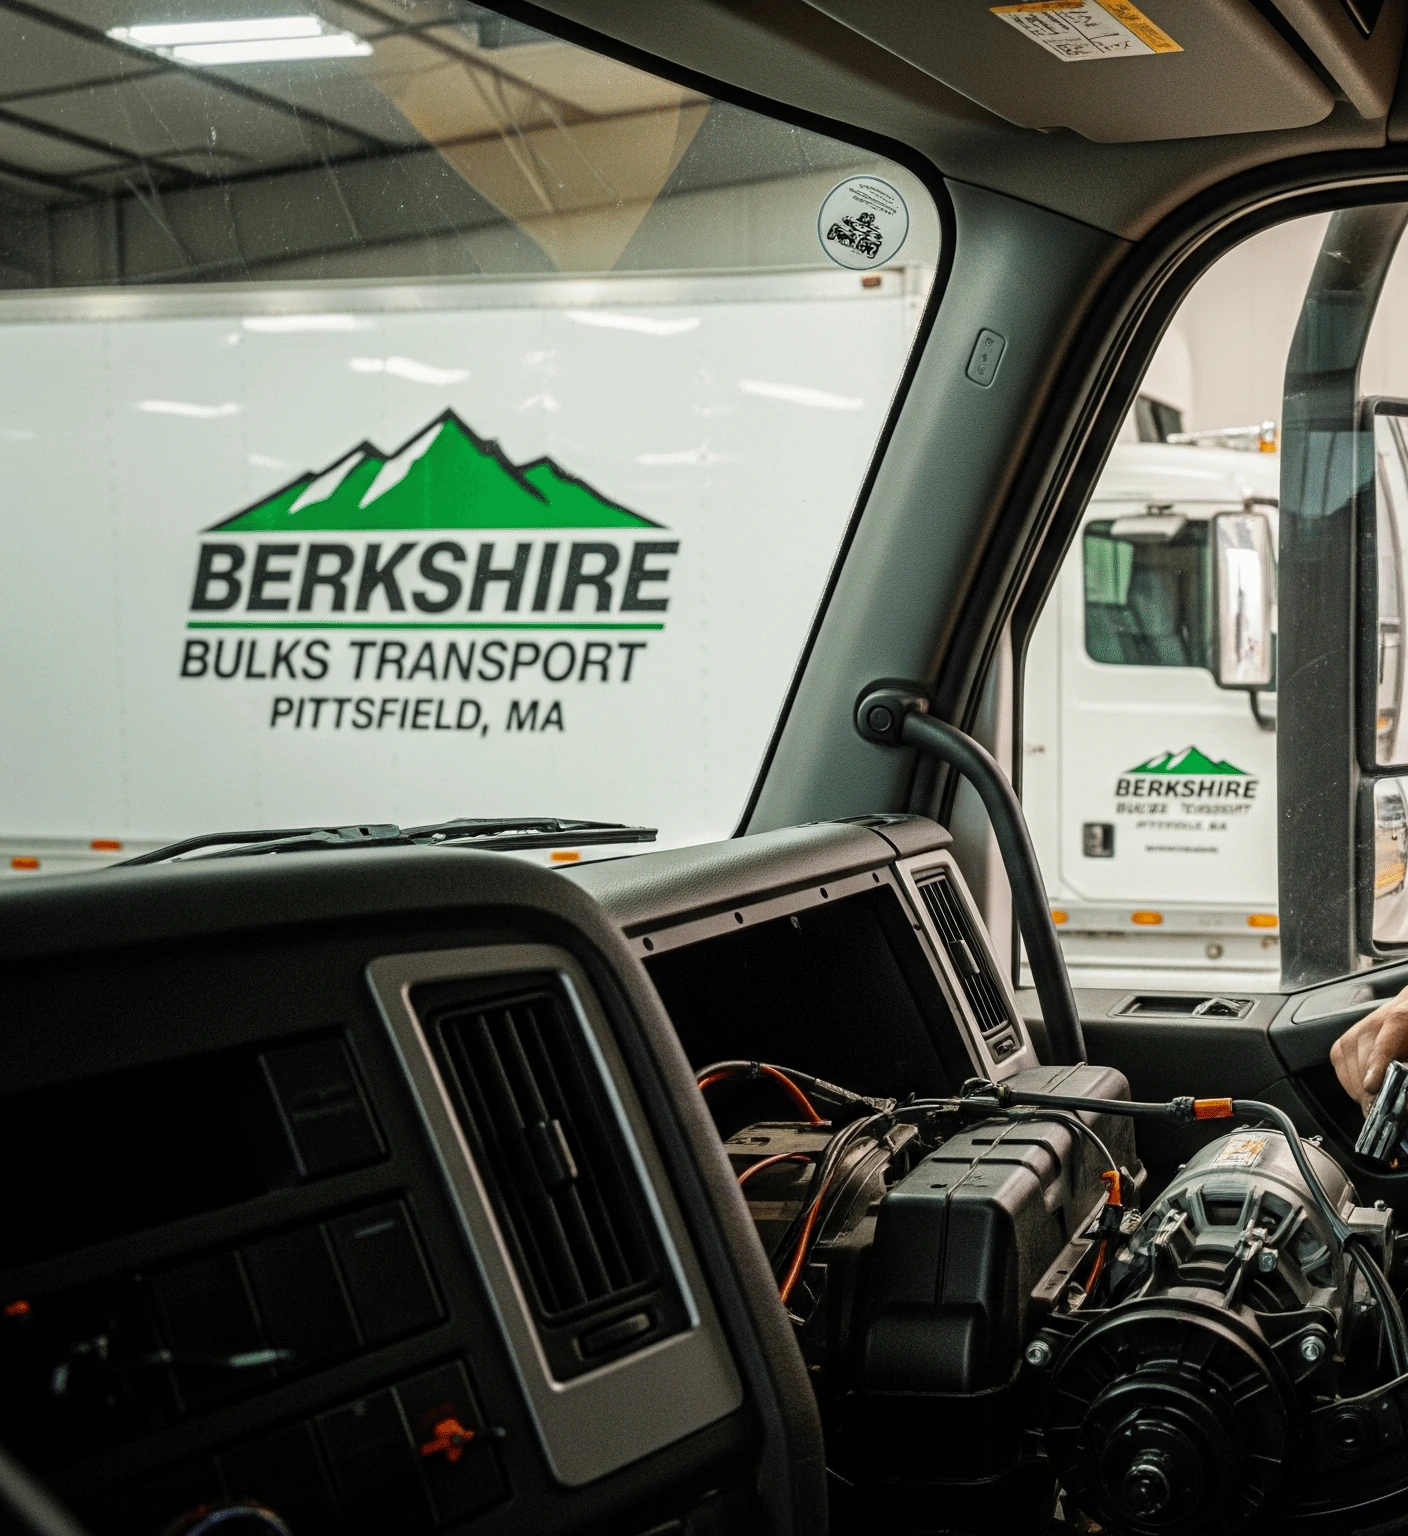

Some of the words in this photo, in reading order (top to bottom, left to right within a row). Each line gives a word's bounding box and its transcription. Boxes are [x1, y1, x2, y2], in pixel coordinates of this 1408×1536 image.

[188, 541, 681, 613] BERKSHIRE
[180, 639, 331, 680] BULKS
[349, 641, 647, 683] TRANSPORT
[269, 697, 489, 738] PITTSFIELD,
[504, 700, 566, 733] MA
[1115, 778, 1259, 799] BERKSHIRE
